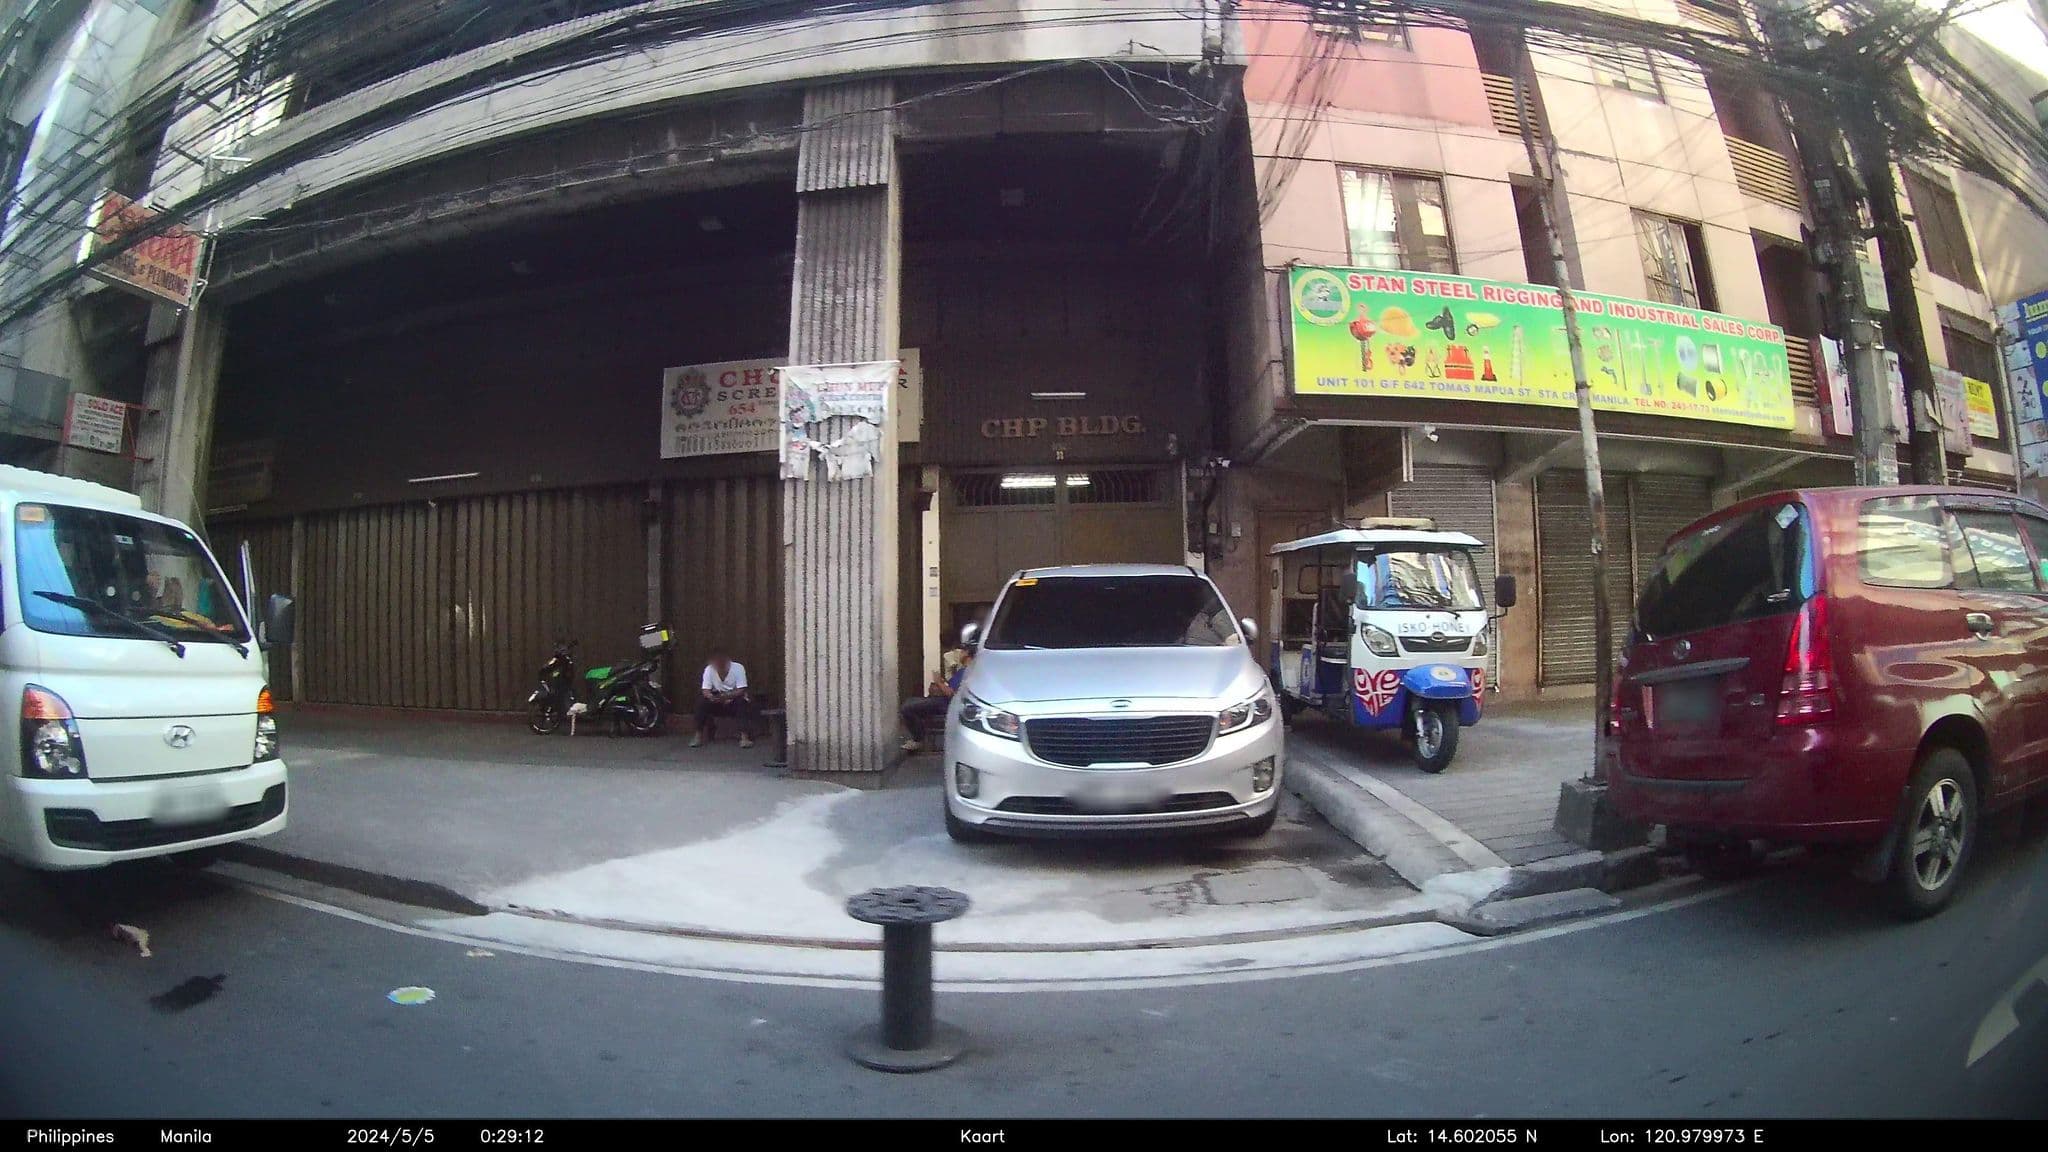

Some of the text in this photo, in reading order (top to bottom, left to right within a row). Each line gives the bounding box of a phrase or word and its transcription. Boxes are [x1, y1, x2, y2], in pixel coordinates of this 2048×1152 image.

[1348, 274, 1405, 293] STAN
[1412, 279, 1478, 300] STEEL
[1483, 286, 1563, 309] RIGGING
[1608, 302, 1699, 329] INDUSTRIAL
[1703, 316, 1744, 336] SALES
[1317, 377, 1348, 387] UNIT
[1354, 378, 1375, 388] 101
[1430, 381, 1471, 393] TOMAS
[1474, 385, 1514, 396] MAPUA
[1592, 393, 1630, 406] MANILA
[728, 402, 757, 416] 654
[981, 415, 1146, 438] CHP BLDG.
